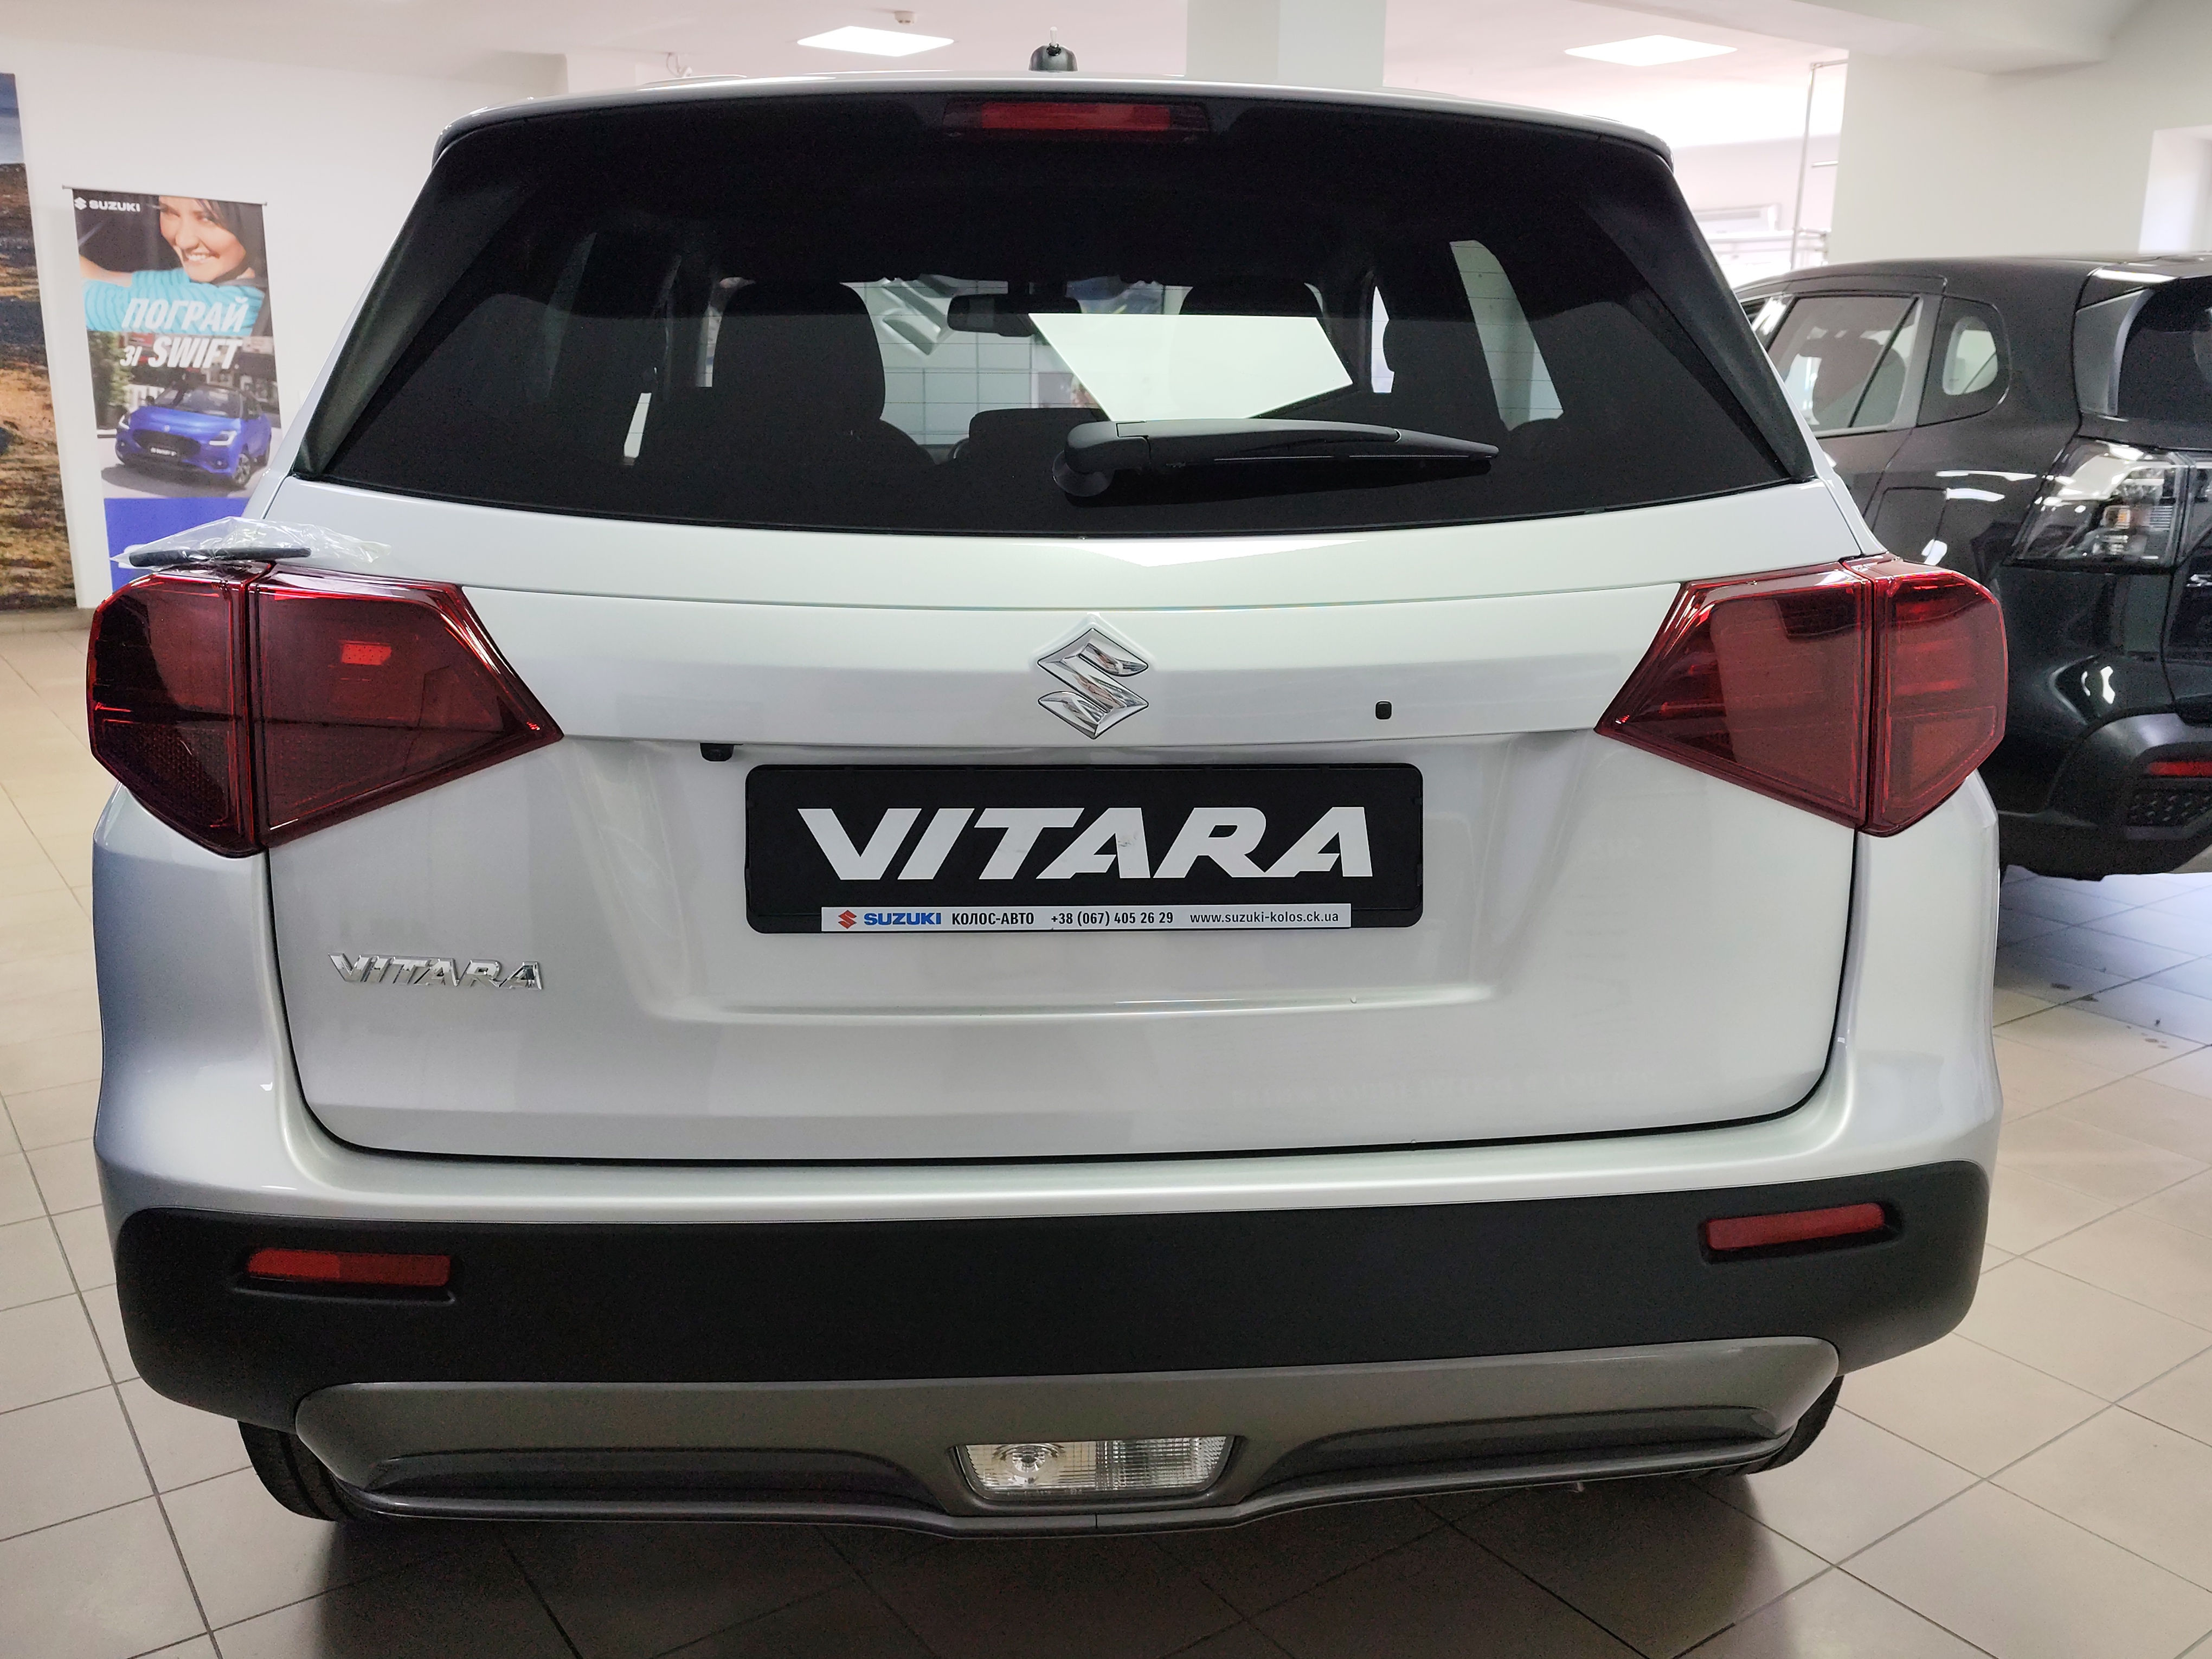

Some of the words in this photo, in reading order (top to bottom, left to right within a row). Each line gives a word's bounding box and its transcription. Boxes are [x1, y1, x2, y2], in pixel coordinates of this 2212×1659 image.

[89, 200, 140, 212] SUZUKI
[121, 297, 249, 332] ПОГРАЙ
[148, 336, 243, 369] SWIFT
[798, 807, 1373, 880] VITARA
[864, 912, 941, 925] SUZUKI
[951, 912, 1034, 925] КОЛОС-АВТО
[1051, 912, 1073, 924] +38
[1077, 911, 1110, 927] (067)
[1114, 912, 1136, 924] 405
[1140, 912, 1155, 924] 26
[1159, 912, 1174, 924] 29
[1190, 911, 1339, 923] www.suzuki-kolos.ck.ua
[328, 953, 543, 990] VITARA
